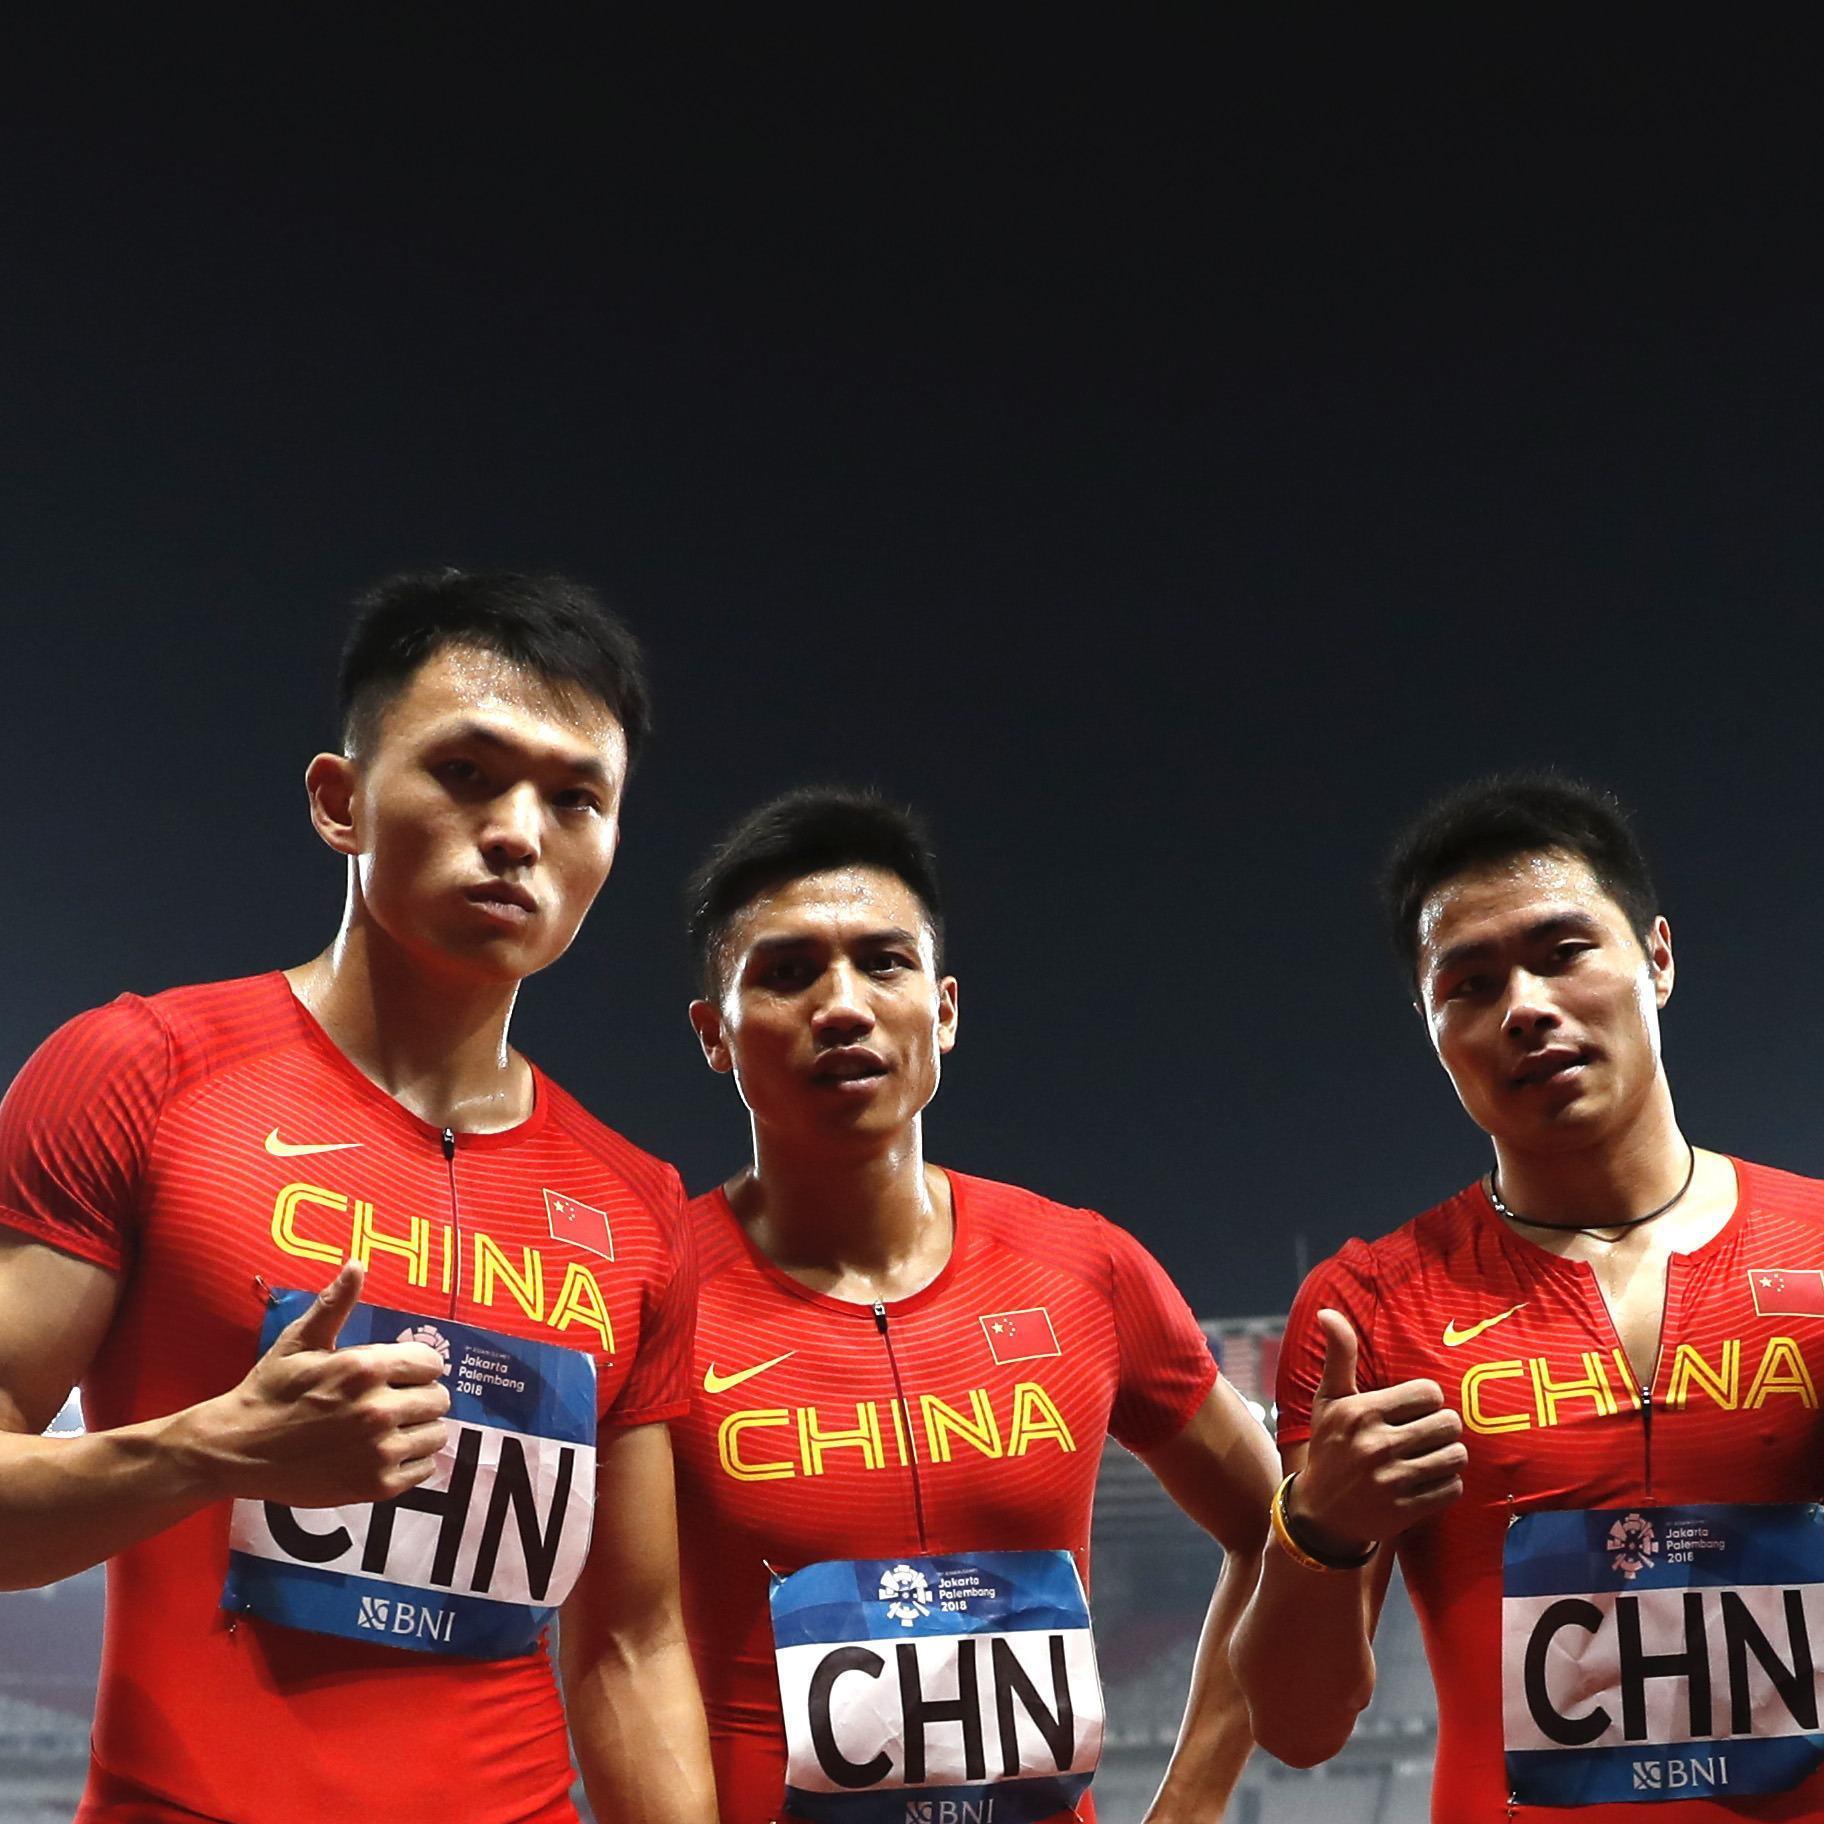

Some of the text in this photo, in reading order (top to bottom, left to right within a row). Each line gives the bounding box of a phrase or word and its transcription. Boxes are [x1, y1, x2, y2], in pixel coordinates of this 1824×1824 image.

[270, 1182, 615, 1354] CHINA
[461, 1353, 508, 1374] Jakarta
[456, 1380, 483, 1396] 2018
[458, 1366, 525, 1392] Palembang
[1461, 1336, 1819, 1434] CHINA
[717, 1381, 1077, 1482] CHINA
[1665, 1527, 1709, 1539] Jakarta
[1666, 1539, 1726, 1551] Palembang
[1667, 1552, 1694, 1563] 2018
[938, 1576, 980, 1589] Jakarta
[938, 1587, 996, 1599] Palembang
[941, 1600, 967, 1612] 2018
[391, 1600, 457, 1643] BNI
[1524, 1589, 1820, 1746] CHN
[807, 1633, 1076, 1789] CHN
[1667, 1756, 1728, 1790] BNI
